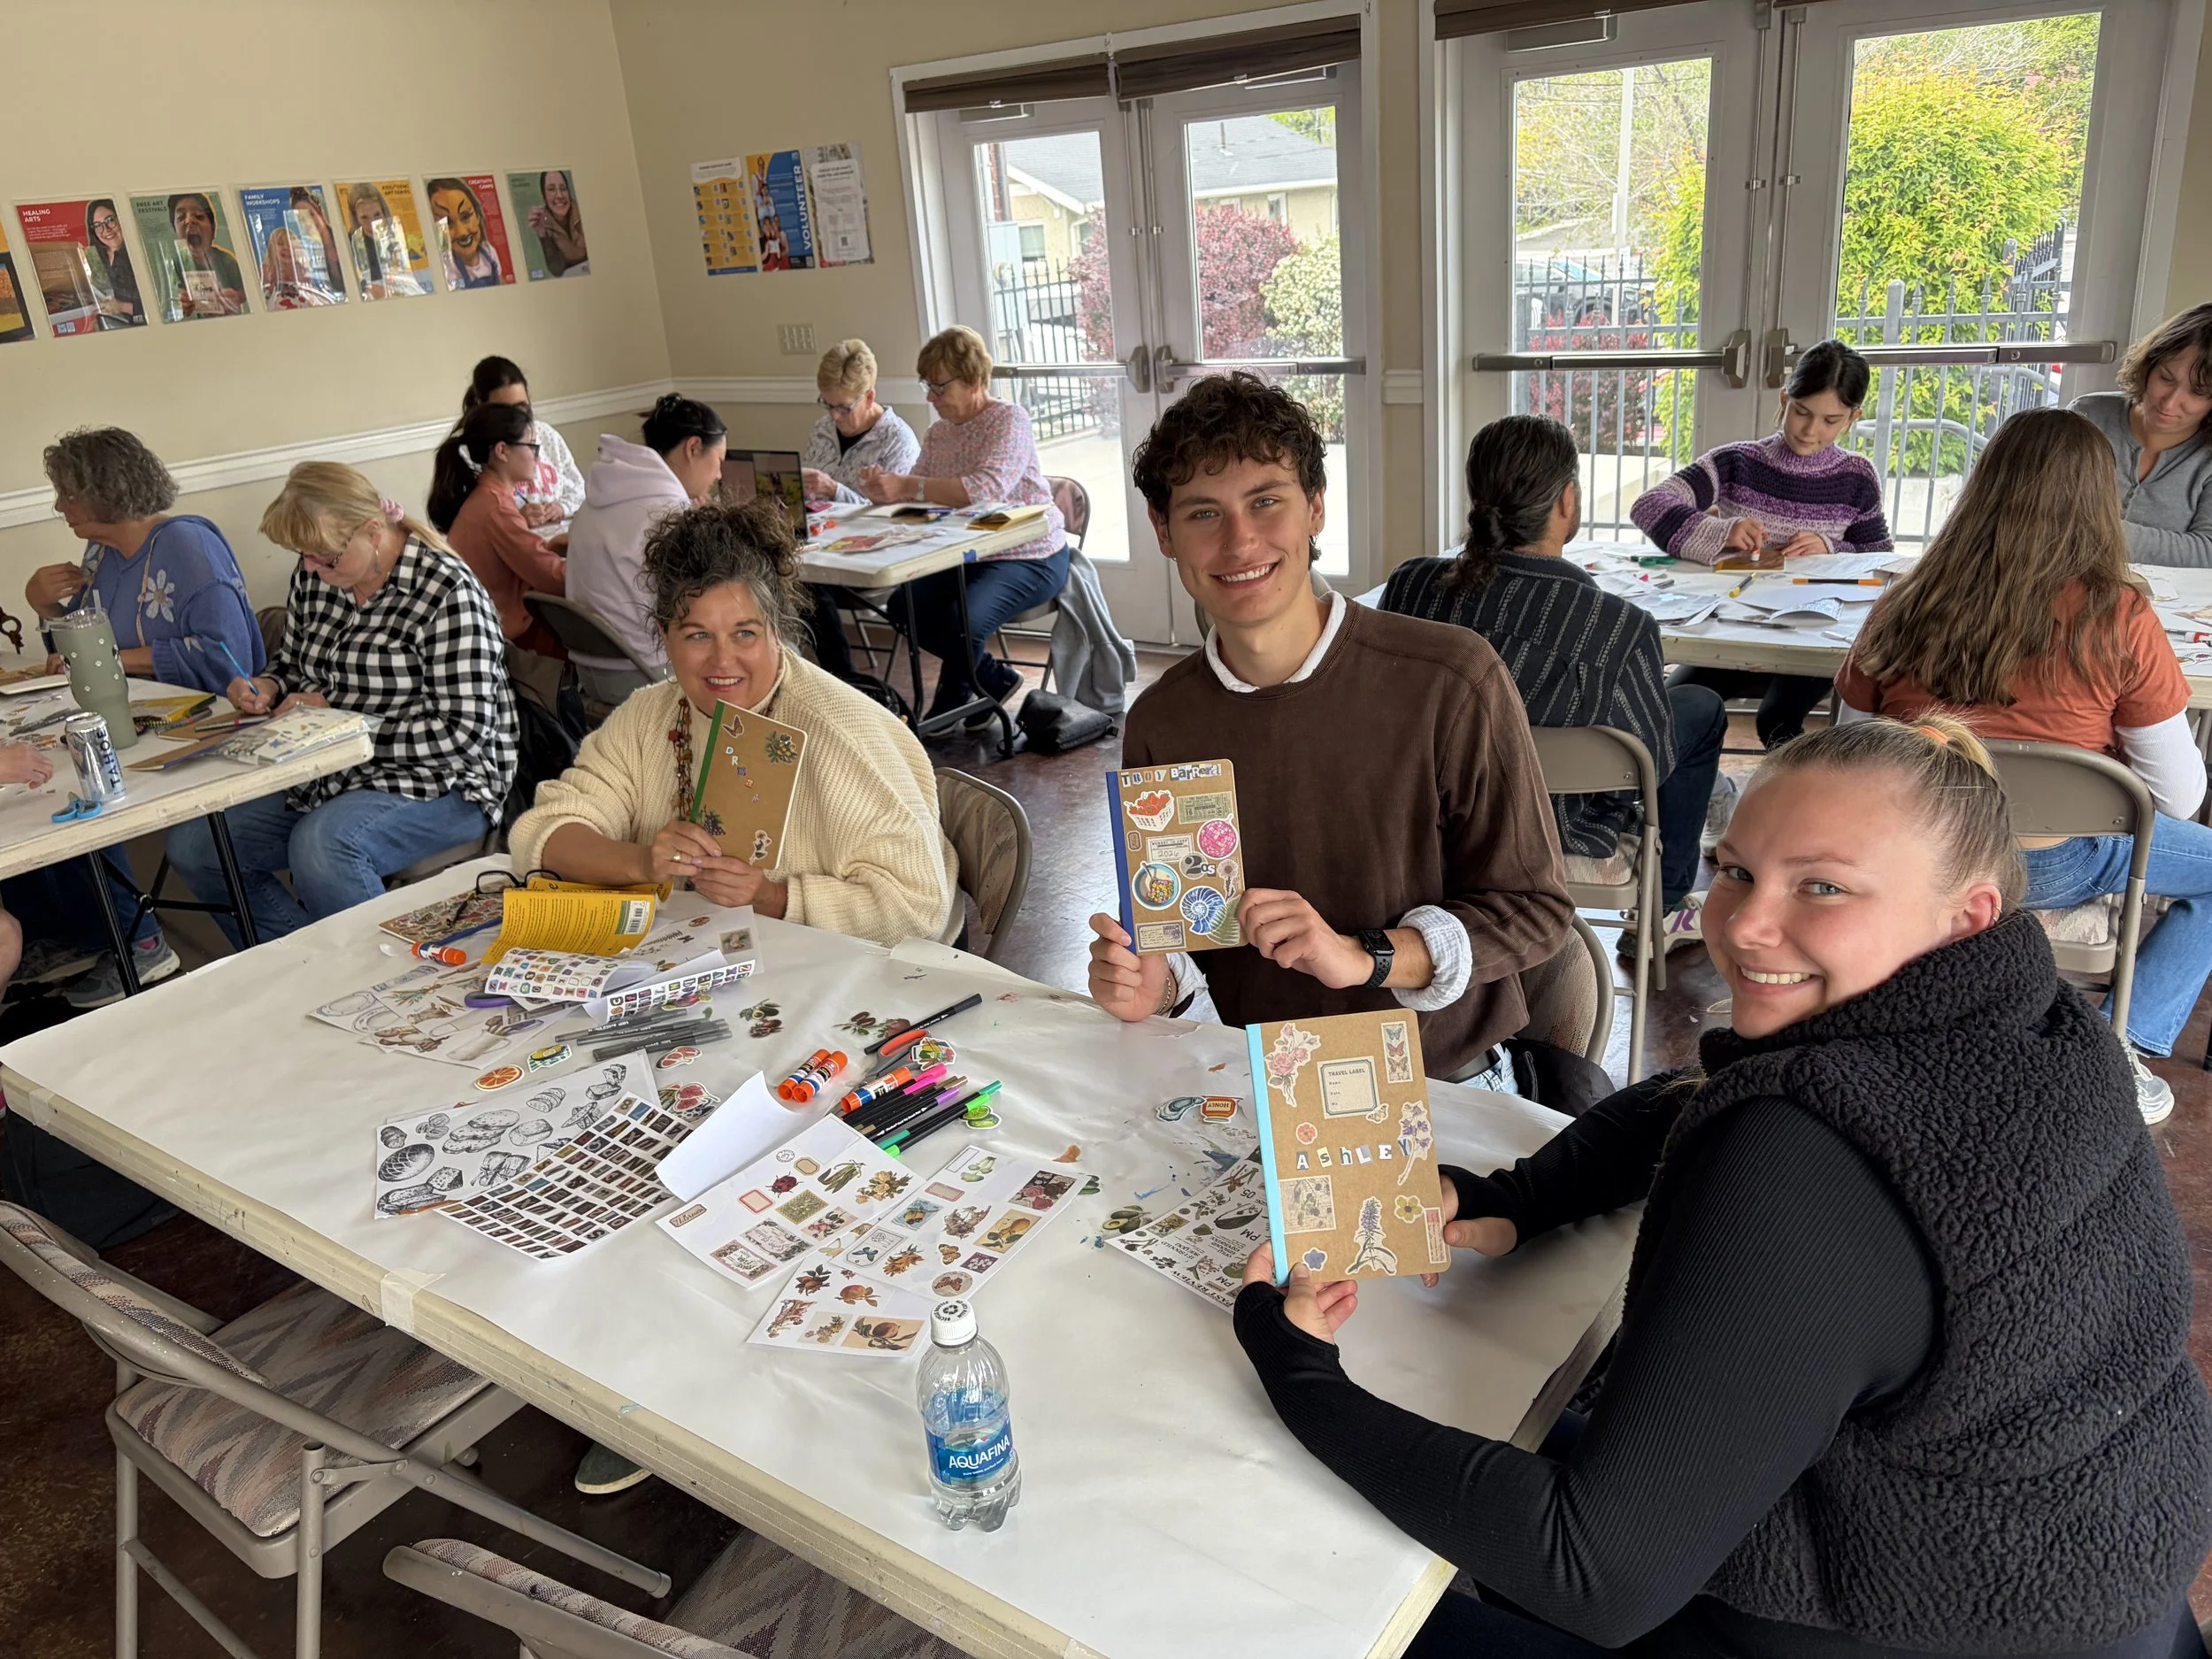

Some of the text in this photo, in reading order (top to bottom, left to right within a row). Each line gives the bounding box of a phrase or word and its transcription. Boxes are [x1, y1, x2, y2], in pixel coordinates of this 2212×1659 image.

[22, 208, 51, 217] HEALING
[794, 165, 811, 250] VOLUNTEER
[96, 727, 120, 788] TAHOE
[1240, 1229, 1261, 1241] PM
[1171, 1271, 1233, 1308] PAST REVIEW
[1216, 1276, 1235, 1287] PM
[949, 1434, 1010, 1469] AQUAFINA
